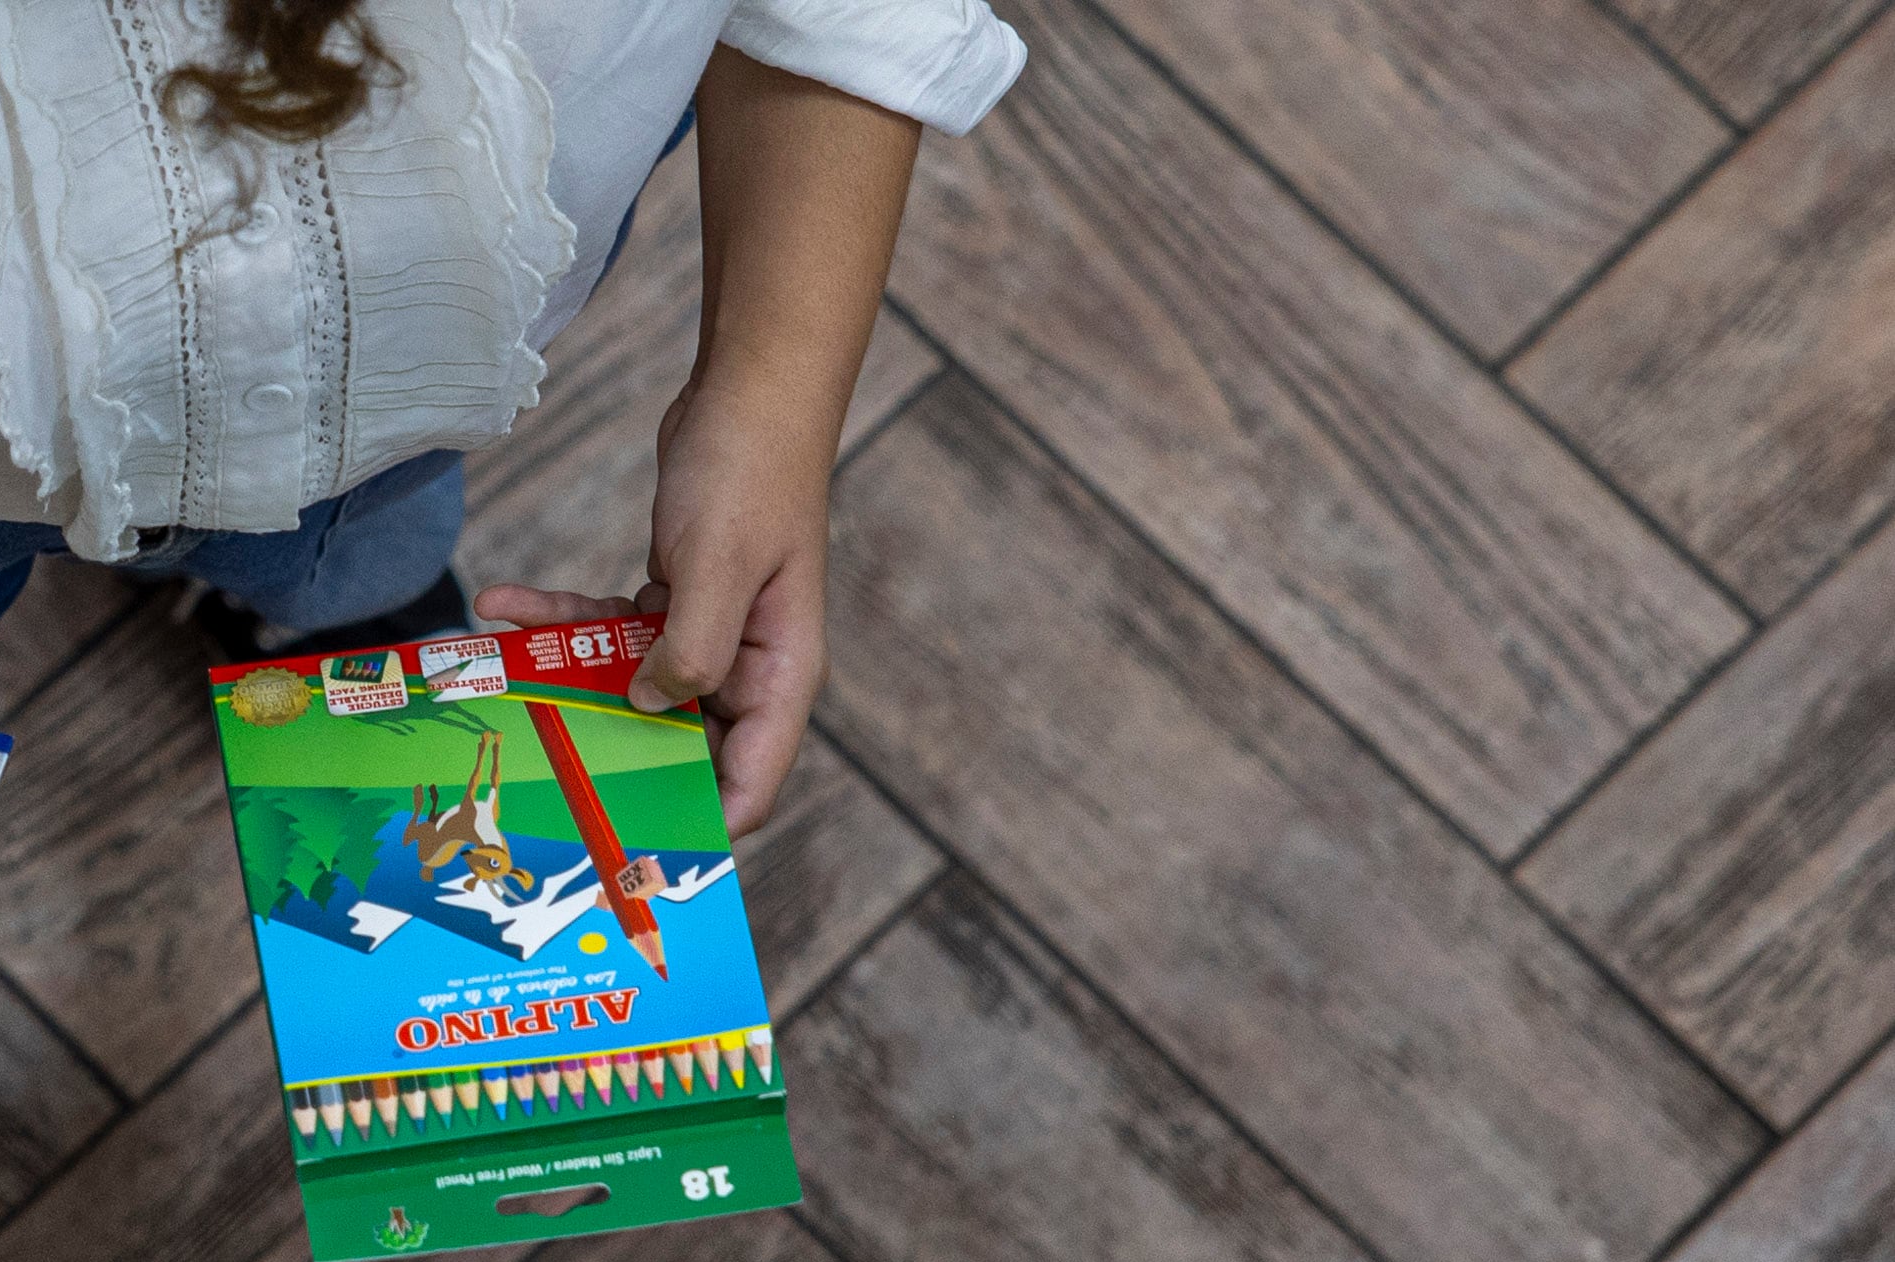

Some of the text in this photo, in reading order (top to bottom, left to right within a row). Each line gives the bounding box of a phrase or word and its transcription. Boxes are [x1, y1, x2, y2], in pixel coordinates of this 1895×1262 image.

[428, 639, 495, 654] RESISTANT
[457, 646, 497, 658] BREAK
[569, 632, 616, 659] 18
[329, 681, 402, 697] SLIDING PACK
[428, 675, 503, 691] RESISTENTE
[472, 683, 504, 693] MINA
[329, 689, 403, 706] DESLIZABLE
[347, 698, 405, 712] ESTUCHE
[623, 874, 646, 894] 10
[487, 984, 510, 1004] de
[515, 975, 578, 996] colores
[417, 993, 458, 1012] vida
[394, 986, 640, 1052] ALPINO
[435, 1146, 663, 1189] Lápiz Sin Madera Wood Free Pencil
[680, 1165, 735, 1201] 18
